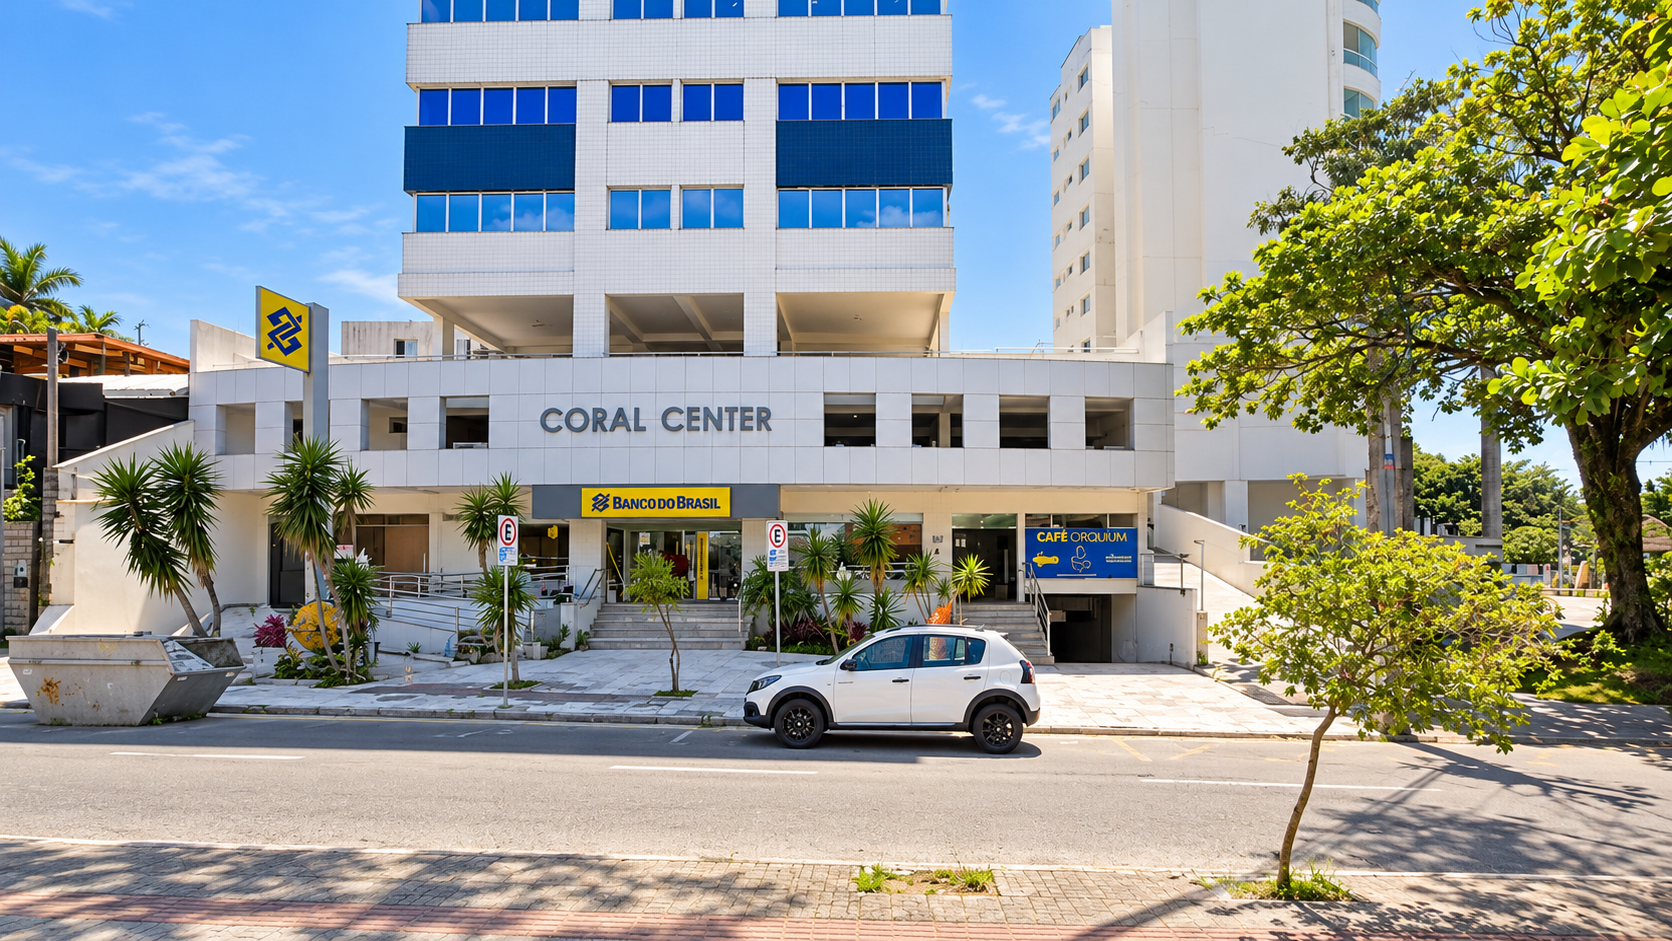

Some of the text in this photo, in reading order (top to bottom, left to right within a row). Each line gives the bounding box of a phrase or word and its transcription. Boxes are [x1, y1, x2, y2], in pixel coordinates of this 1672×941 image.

[540, 406, 772, 432] CORAL CENTER
[613, 495, 721, 510] BANCO DO BRASIL
[505, 524, 511, 541] E
[774, 529, 781, 543] E
[1037, 529, 1068, 542] CAFÉ
